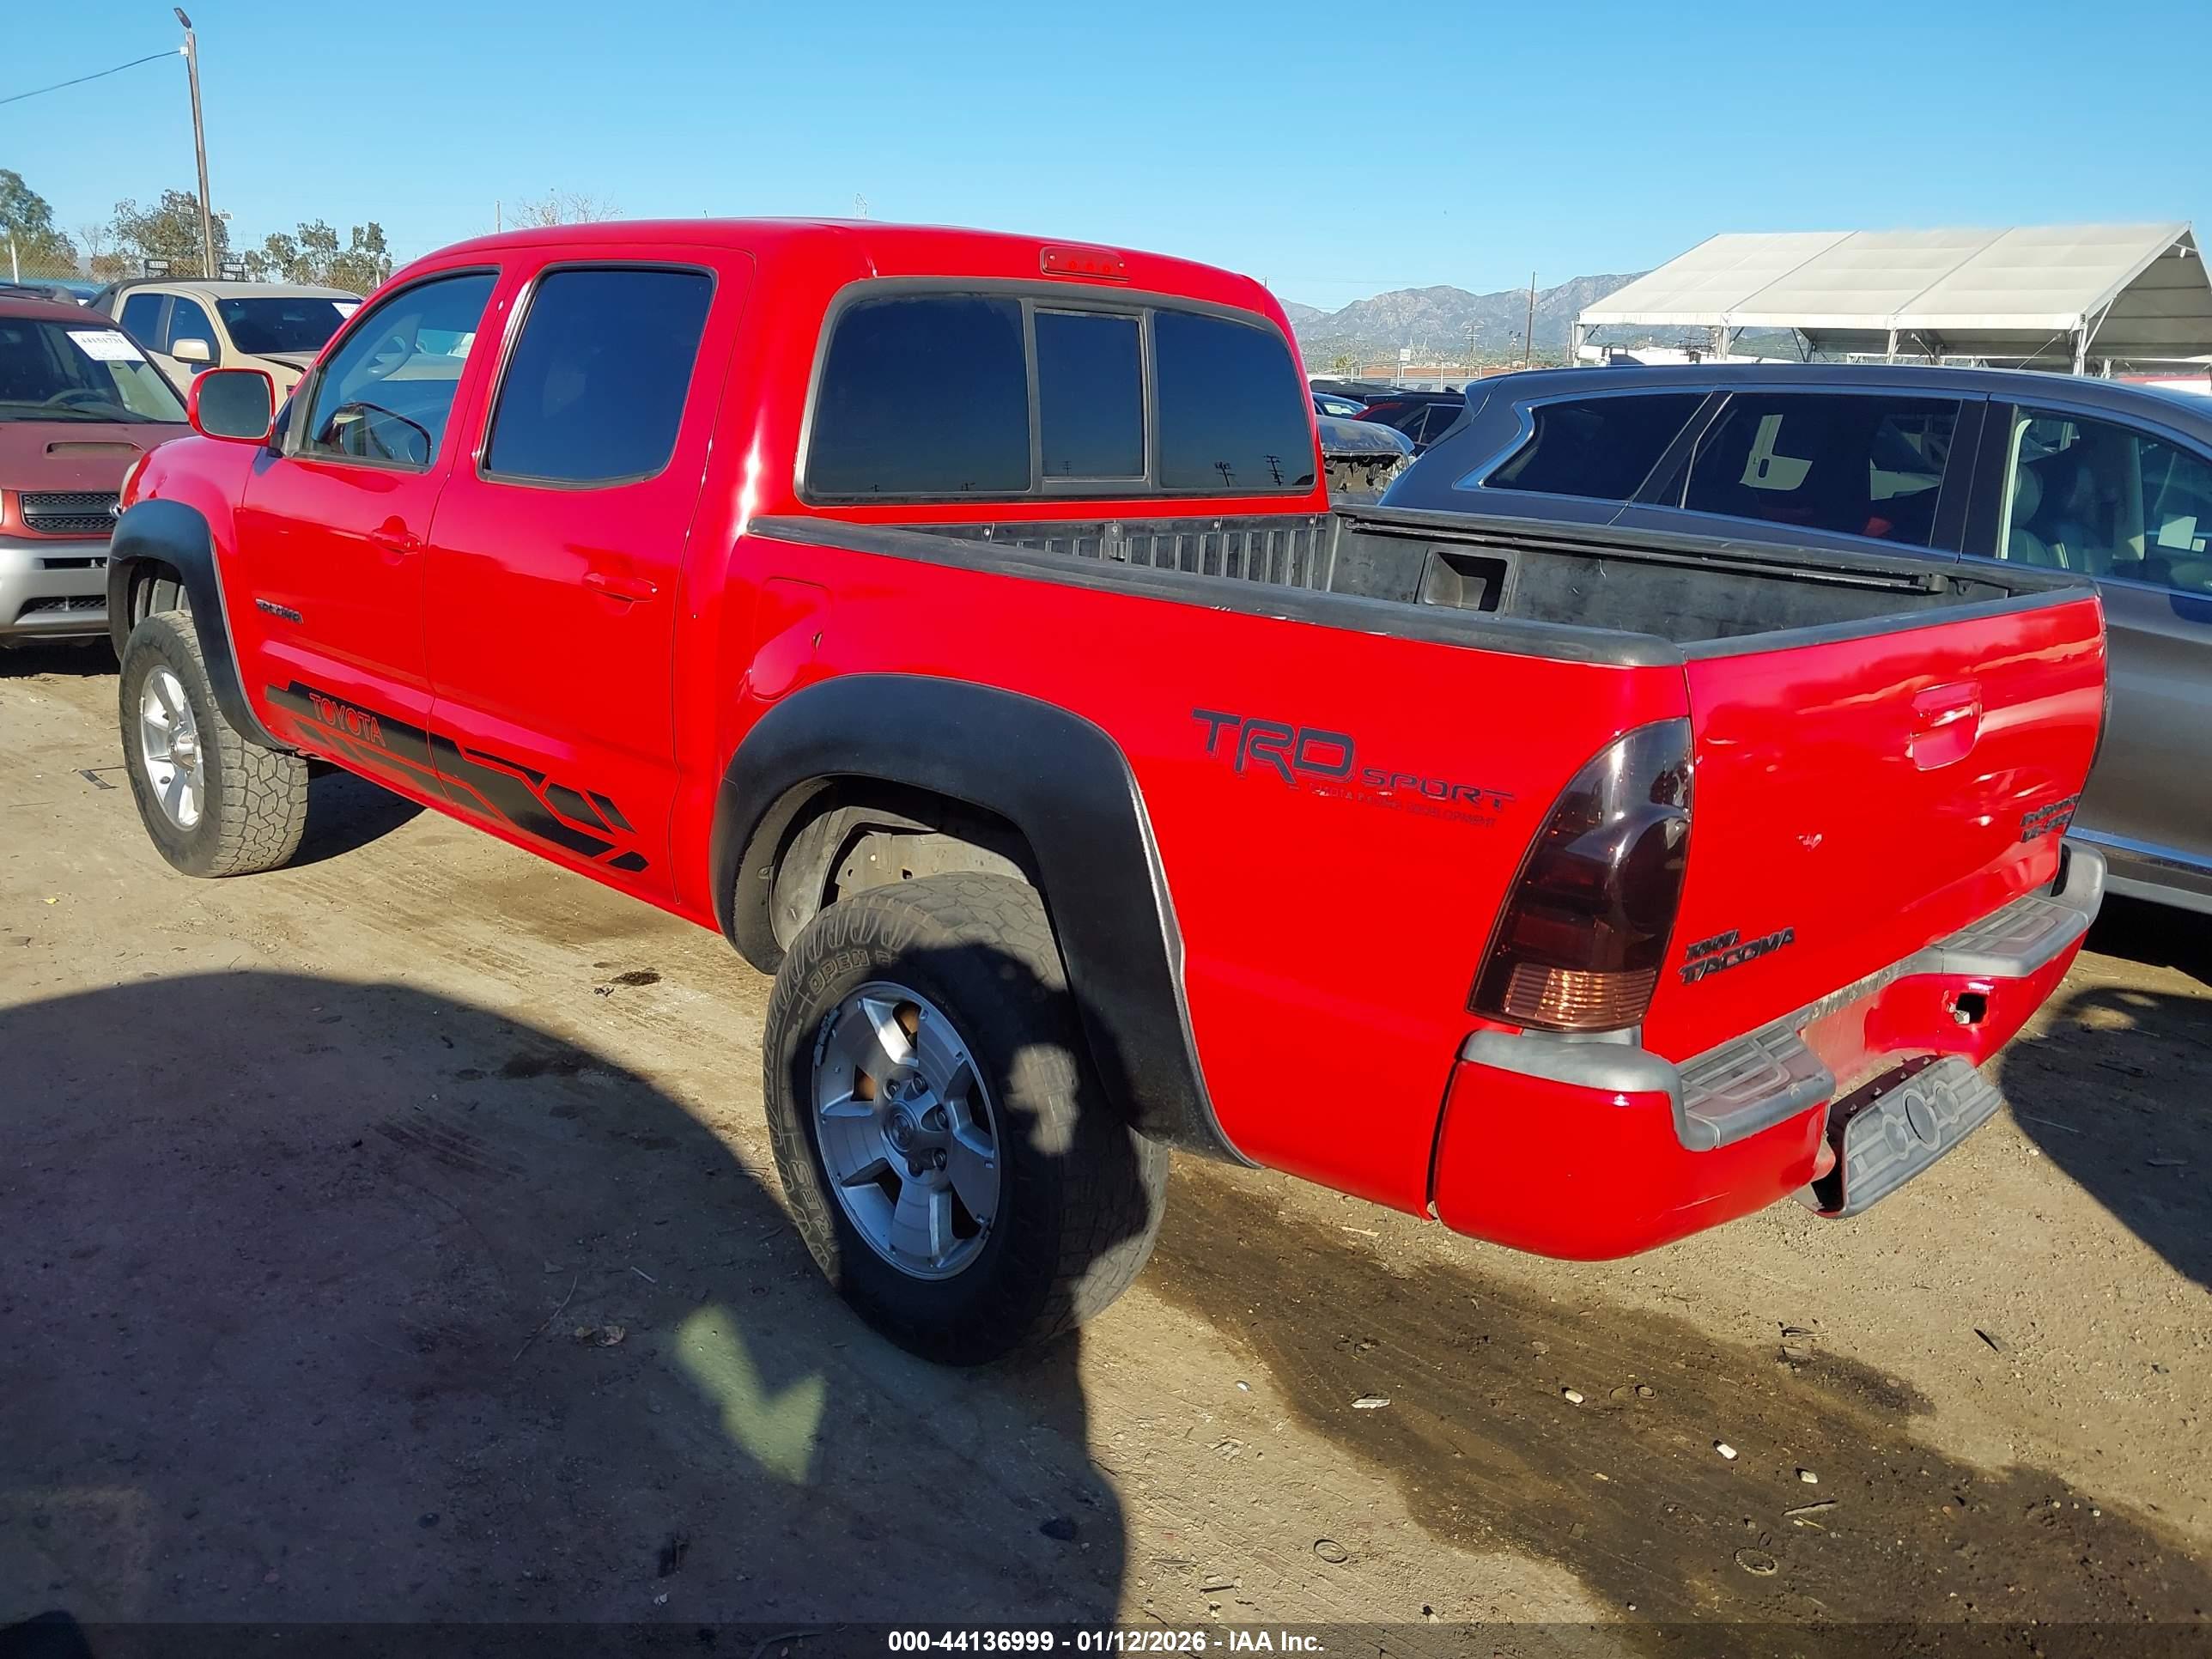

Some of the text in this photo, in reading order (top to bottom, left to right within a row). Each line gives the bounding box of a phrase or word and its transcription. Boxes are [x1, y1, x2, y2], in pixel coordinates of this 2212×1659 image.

[308, 692, 386, 747] TOYOTA
[1191, 708, 1516, 811] TRD SPORT
[808, 949, 872, 994] OPEN
[1678, 927, 1796, 985] TACOMA
